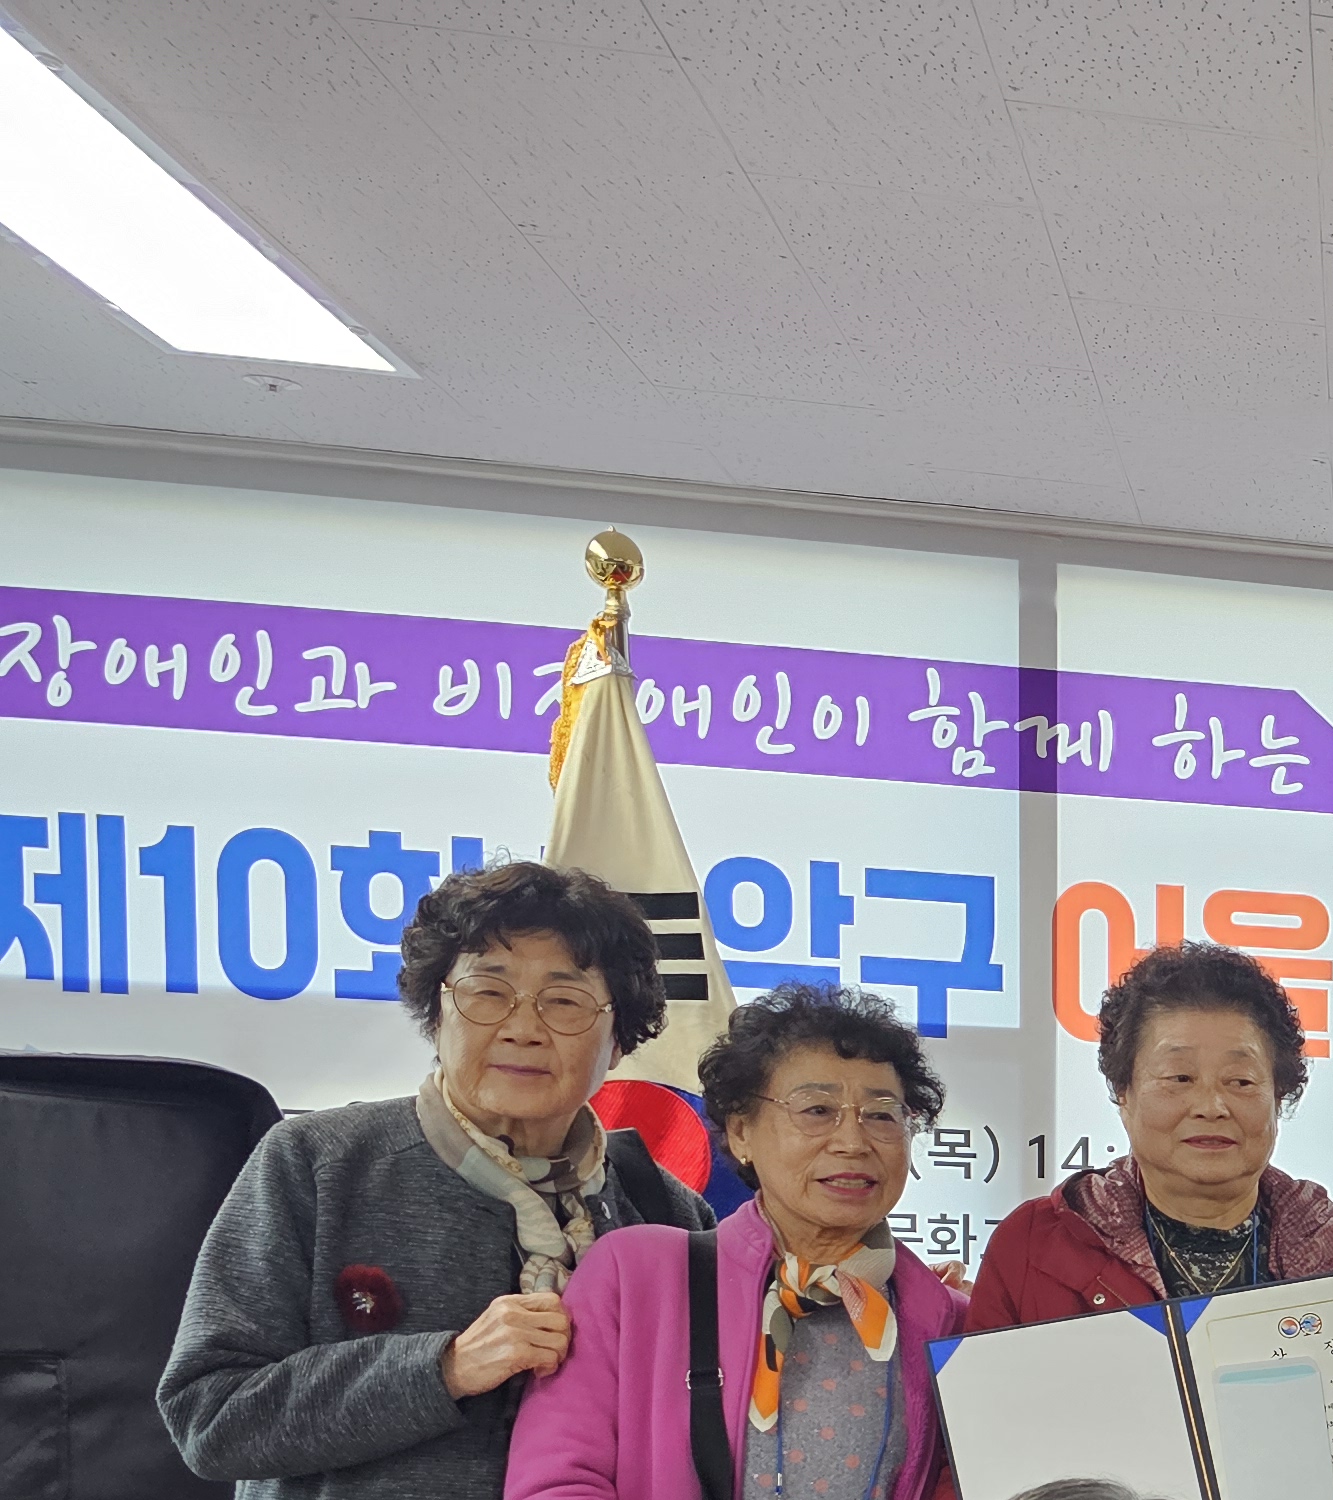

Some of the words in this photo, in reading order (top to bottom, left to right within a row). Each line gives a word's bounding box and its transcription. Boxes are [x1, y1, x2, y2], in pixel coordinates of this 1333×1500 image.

[0, 614, 397, 714] 장애인과
[907, 669, 1113, 776] 함께
[1151, 694, 1310, 794] 하는
